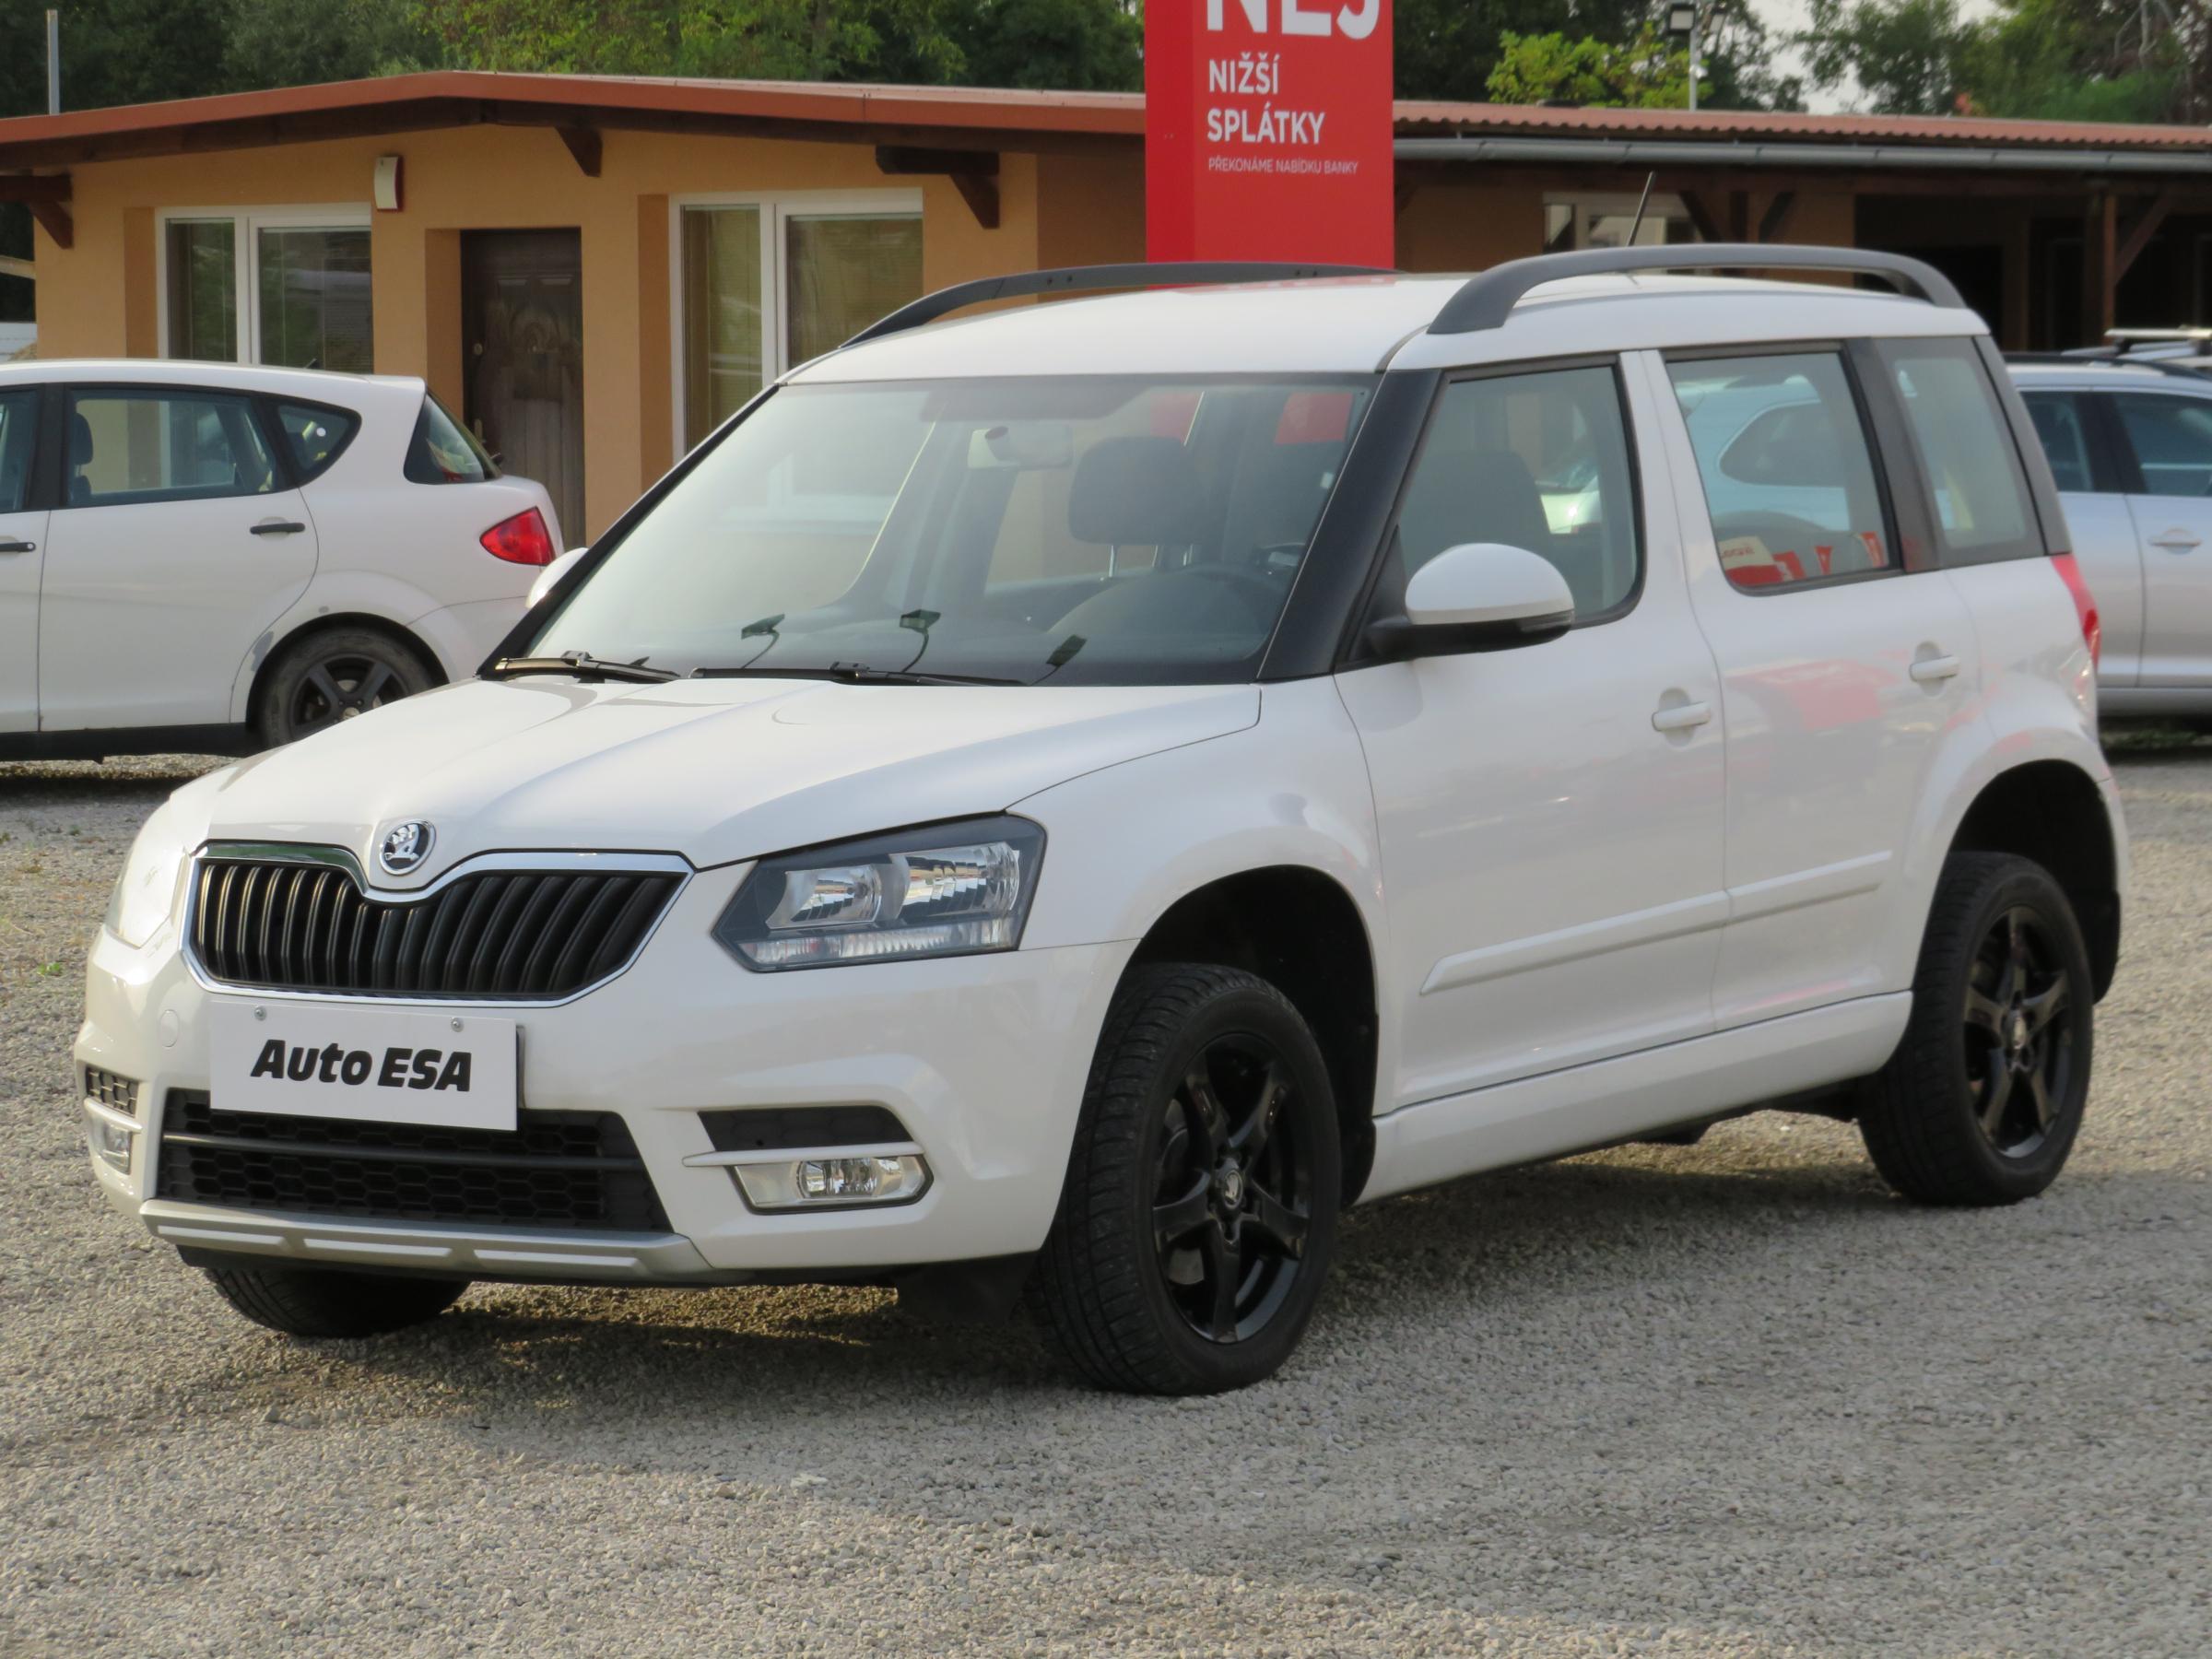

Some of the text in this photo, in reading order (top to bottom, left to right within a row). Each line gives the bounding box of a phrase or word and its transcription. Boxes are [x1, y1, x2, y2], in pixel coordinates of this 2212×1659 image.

[1208, 52, 1279, 94] NIŽŠÍ
[1206, 100, 1325, 144] SPLÁTKY
[1208, 155, 1273, 172] PŘEKONÁME
[1324, 160, 1358, 174] BANKY
[250, 1039, 472, 1092] Auto ESA
